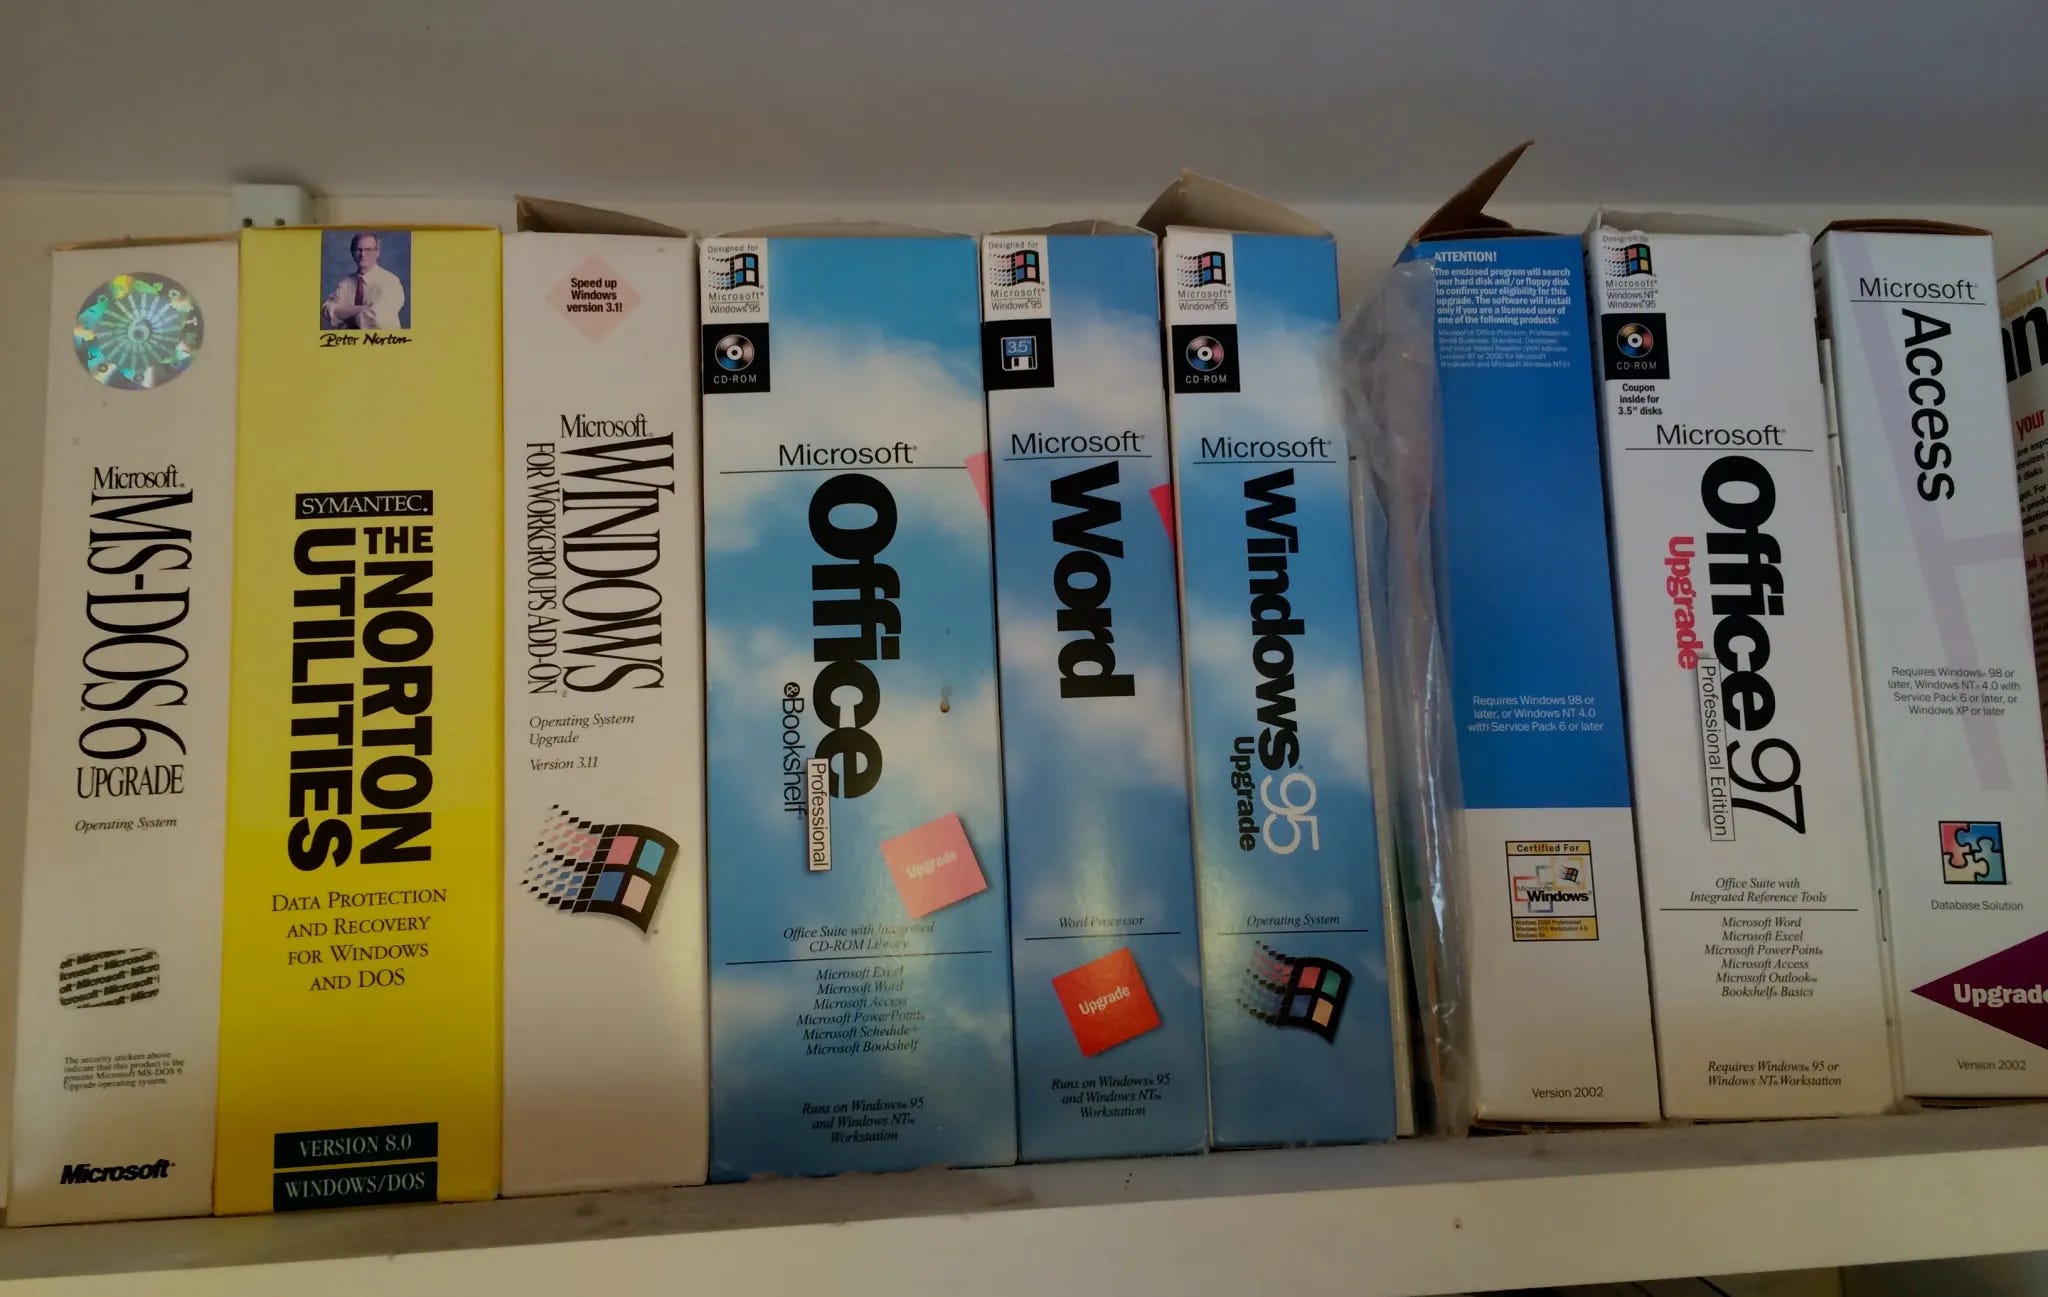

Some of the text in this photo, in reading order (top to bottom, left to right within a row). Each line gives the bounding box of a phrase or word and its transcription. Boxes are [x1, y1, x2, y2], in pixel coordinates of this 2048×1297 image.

[707, 244, 758, 255] Designed for
[988, 241, 1039, 250] Designed for
[1434, 251, 1497, 262] ATTENTION!
[1434, 267, 1571, 279] The enclosed program will search
[571, 277, 617, 290] Speed up
[1605, 280, 1654, 288] Microsoft
[1859, 277, 1976, 300] Microsoft
[571, 289, 617, 300] Windows
[708, 292, 760, 301] Microsoft
[990, 289, 1042, 299] Microsoft
[1178, 290, 1228, 299] Microsoft
[566, 302, 623, 312] version 3.1!
[320, 331, 412, 347] Peter Norton
[1616, 361, 1657, 370] CD-ROM
[713, 374, 757, 384] CD-ROM
[1185, 375, 1227, 384] CD-ROM
[1622, 383, 1655, 394] Coupon
[1619, 395, 1660, 404] inside for
[1902, 308, 1955, 502] Access
[1639, 406, 1662, 416] disks
[560, 413, 648, 438] Microsoft
[1011, 430, 1141, 455] Microsoft
[1656, 424, 1783, 446] Microsoft
[779, 442, 914, 466] Microsoft
[1201, 436, 1329, 460] Microsoft
[93, 464, 180, 490] Microsoft
[526, 442, 562, 694] FOR WORKGROUPS ADD-ON
[560, 431, 675, 693] WINDOWS
[1051, 460, 1135, 699] Word
[81, 489, 193, 711] MS-DOS
[1664, 536, 1704, 670] Upgrade
[808, 473, 902, 799] Office
[1701, 455, 1806, 834] Office 97
[1244, 467, 1320, 855] Windows 95
[1892, 667, 2015, 678] Requires Windows 98 or
[288, 527, 356, 871] UTILITIES
[360, 525, 434, 865] THE NORTON
[1472, 695, 1595, 707] Requires Windows 98 or
[1501, 711, 1512, 719] or
[1513, 709, 1560, 718] Windows
[1562, 709, 1577, 718] NT
[1578, 708, 1596, 718] 4.0
[529, 713, 635, 731] Operating System
[1467, 721, 1605, 732] with Service Pack 6 or later
[79, 718, 187, 759] 6
[529, 732, 579, 748] Upgrade
[1701, 664, 1728, 837] Professional Edition
[530, 756, 599, 771] Version 3.11
[77, 764, 184, 798] UPGRADE
[1229, 736, 1256, 852] Upgrade
[810, 762, 829, 867] Professional
[75, 817, 177, 833] Operating System
[1516, 843, 1580, 853] Certified For
[905, 850, 959, 879] Upgrade
[1715, 877, 1801, 891] Office Suite with
[1527, 890, 1590, 902] Windows
[1690, 891, 1828, 904] Integrated Reference Tools
[1931, 899, 2023, 911] Database Solution
[1247, 913, 1340, 928] Operating System
[1722, 916, 1802, 930] Microsoft Word
[359, 968, 405, 988] DOS
[1079, 985, 1130, 1015] Upgrade
[1721, 986, 1814, 999] Bookshelf Basics
[805, 1039, 919, 1056] Microsoft Bookshelf
[1708, 1061, 1840, 1074] Requires Windows 95 or
[1957, 1060, 2027, 1071] Version 2002
[1051, 1073, 1171, 1090] Runs on Windows 95
[1707, 1075, 1756, 1086] Windows
[1780, 1075, 1842, 1087] Workstation
[1062, 1092, 1084, 1104] and
[1086, 1091, 1136, 1104] Windows
[1531, 1086, 1604, 1098] Version 2002
[1080, 1106, 1146, 1119] Workstation
[299, 1133, 412, 1157] VERSION 8.0
[60, 1158, 169, 1185] Microsoft
[285, 1171, 425, 1200] WINDOWS/DOS
